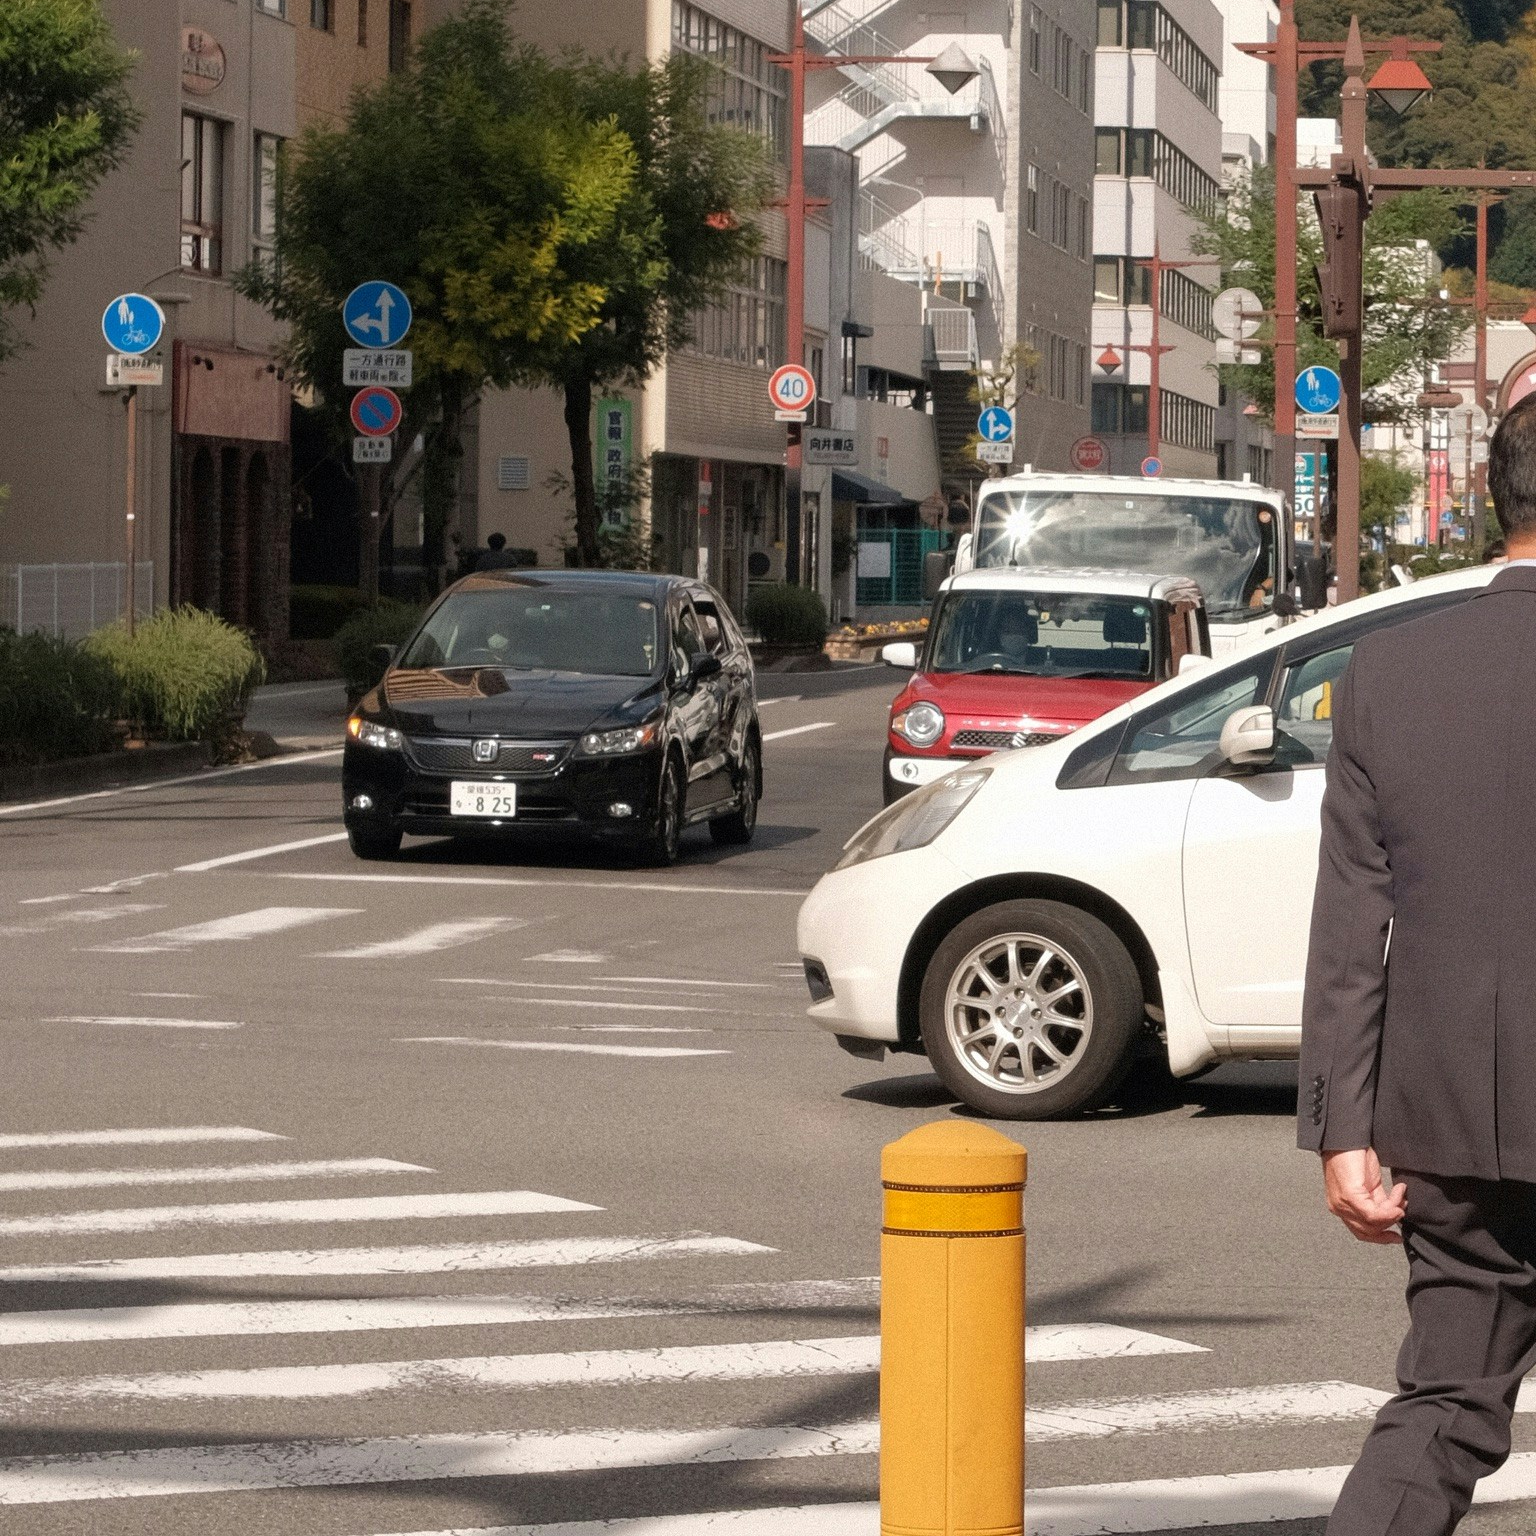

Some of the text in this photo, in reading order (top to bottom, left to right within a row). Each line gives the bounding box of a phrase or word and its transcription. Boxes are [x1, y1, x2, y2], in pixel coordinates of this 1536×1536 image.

[780, 379, 804, 398] 40
[810, 437, 854, 451] 向井書店
